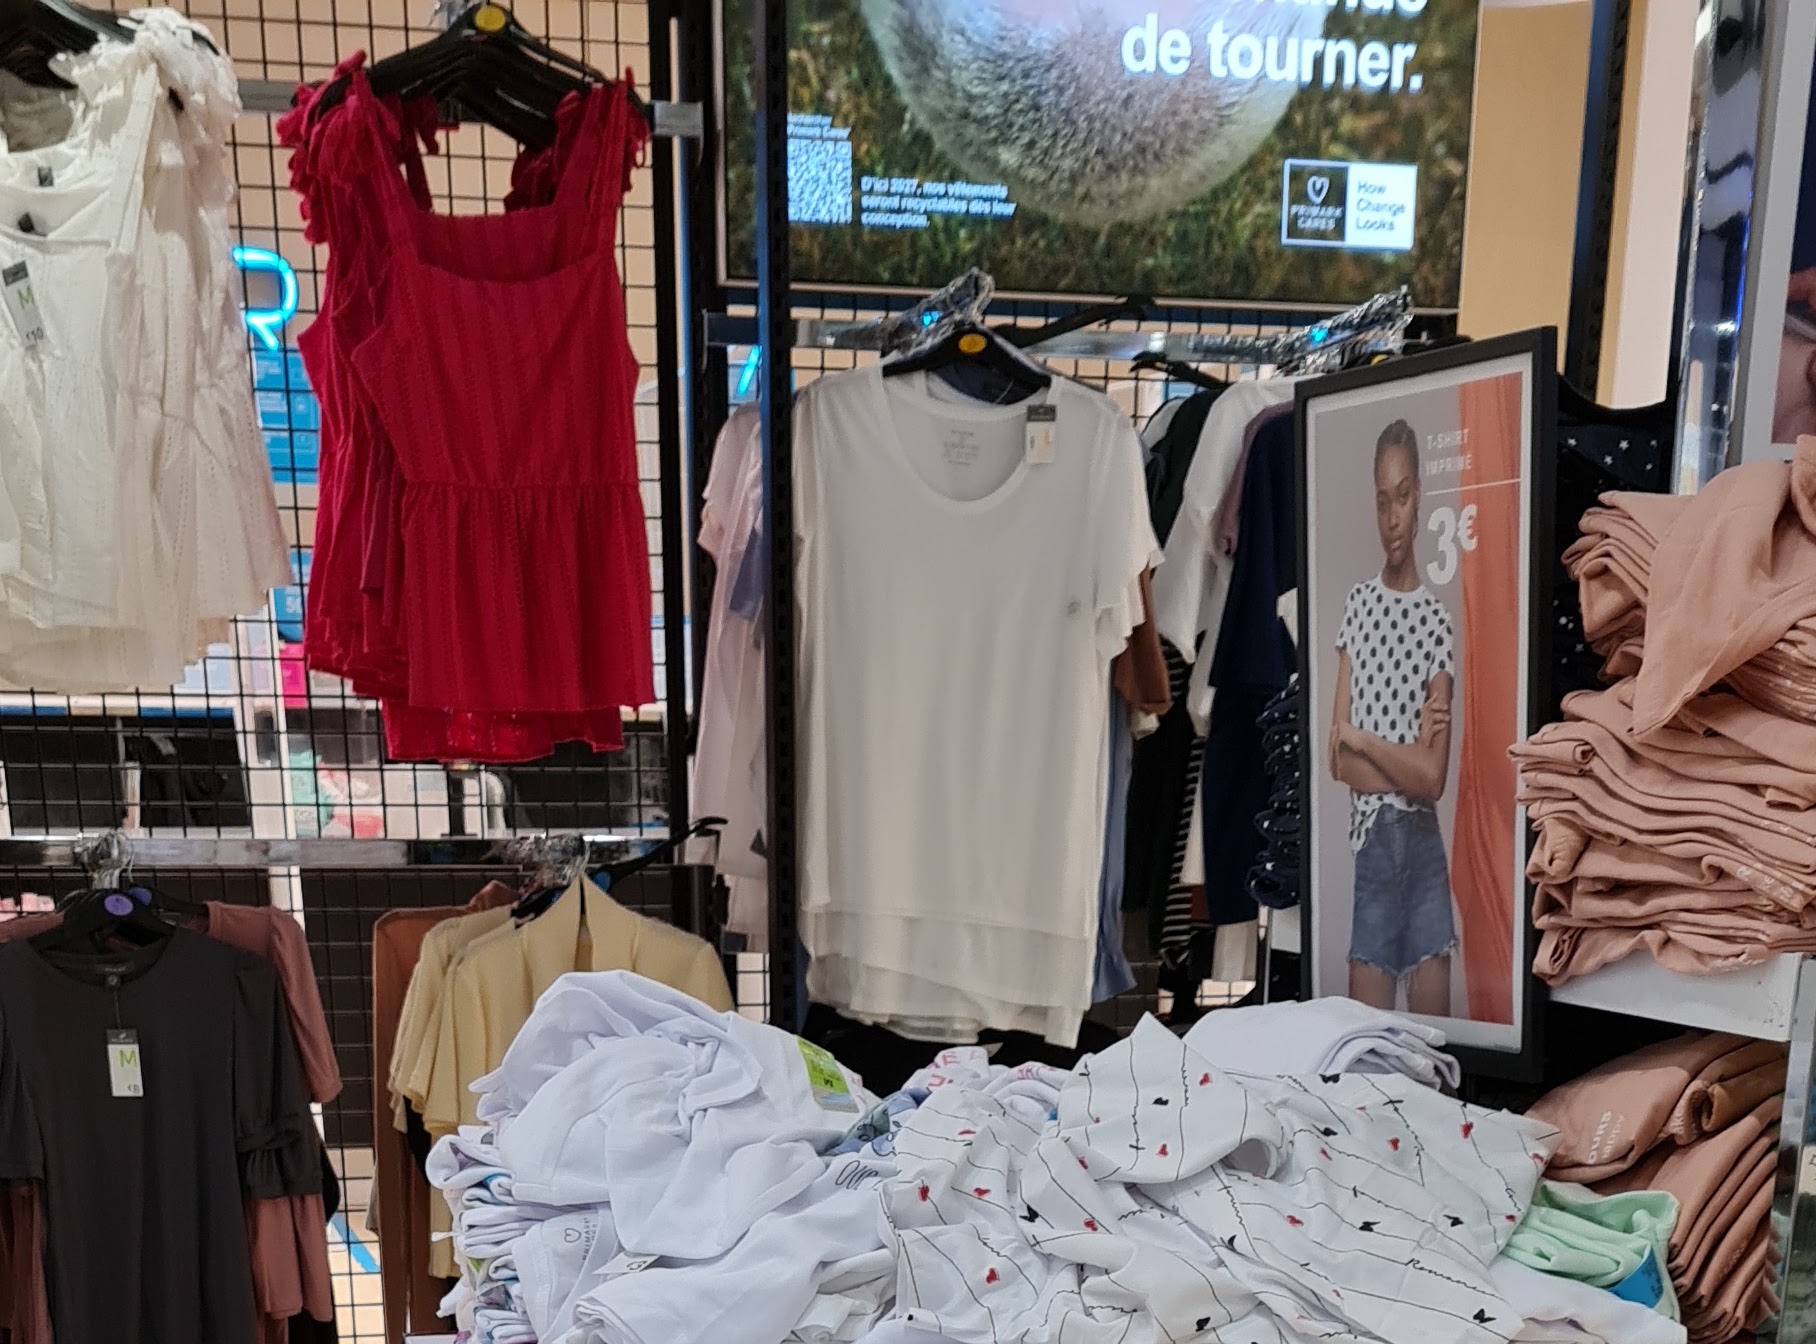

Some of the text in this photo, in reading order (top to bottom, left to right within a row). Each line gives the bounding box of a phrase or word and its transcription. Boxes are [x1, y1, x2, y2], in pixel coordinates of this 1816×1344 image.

[1121, 13, 1424, 90] de tourner.
[1357, 181, 1386, 194] How
[1356, 198, 1406, 216] Change
[1356, 217, 1395, 230] Looks
[1426, 503, 1478, 585] 3€
[119, 1049, 137, 1067] M
